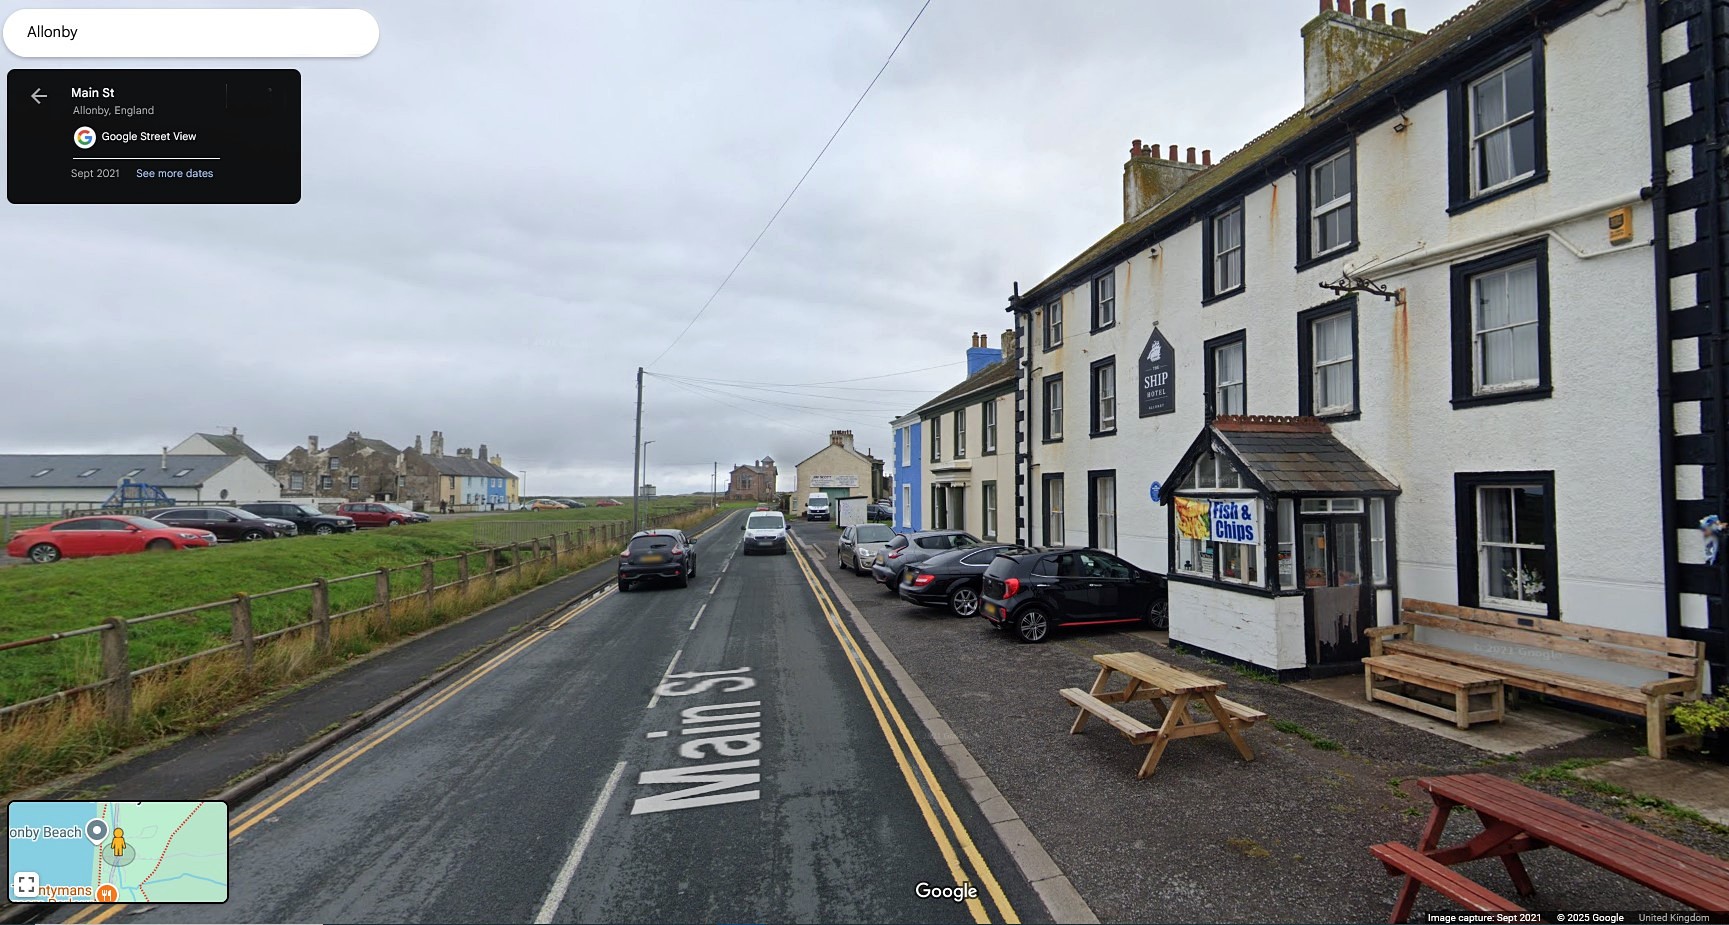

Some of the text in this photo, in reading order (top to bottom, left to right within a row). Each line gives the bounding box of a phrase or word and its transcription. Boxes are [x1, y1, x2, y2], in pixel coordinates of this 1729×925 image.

[1144, 371, 1168, 389] SHIP
[1146, 388, 1166, 398] HOTEL
[1213, 501, 1252, 521] Fish &
[1215, 520, 1254, 542] Chips
